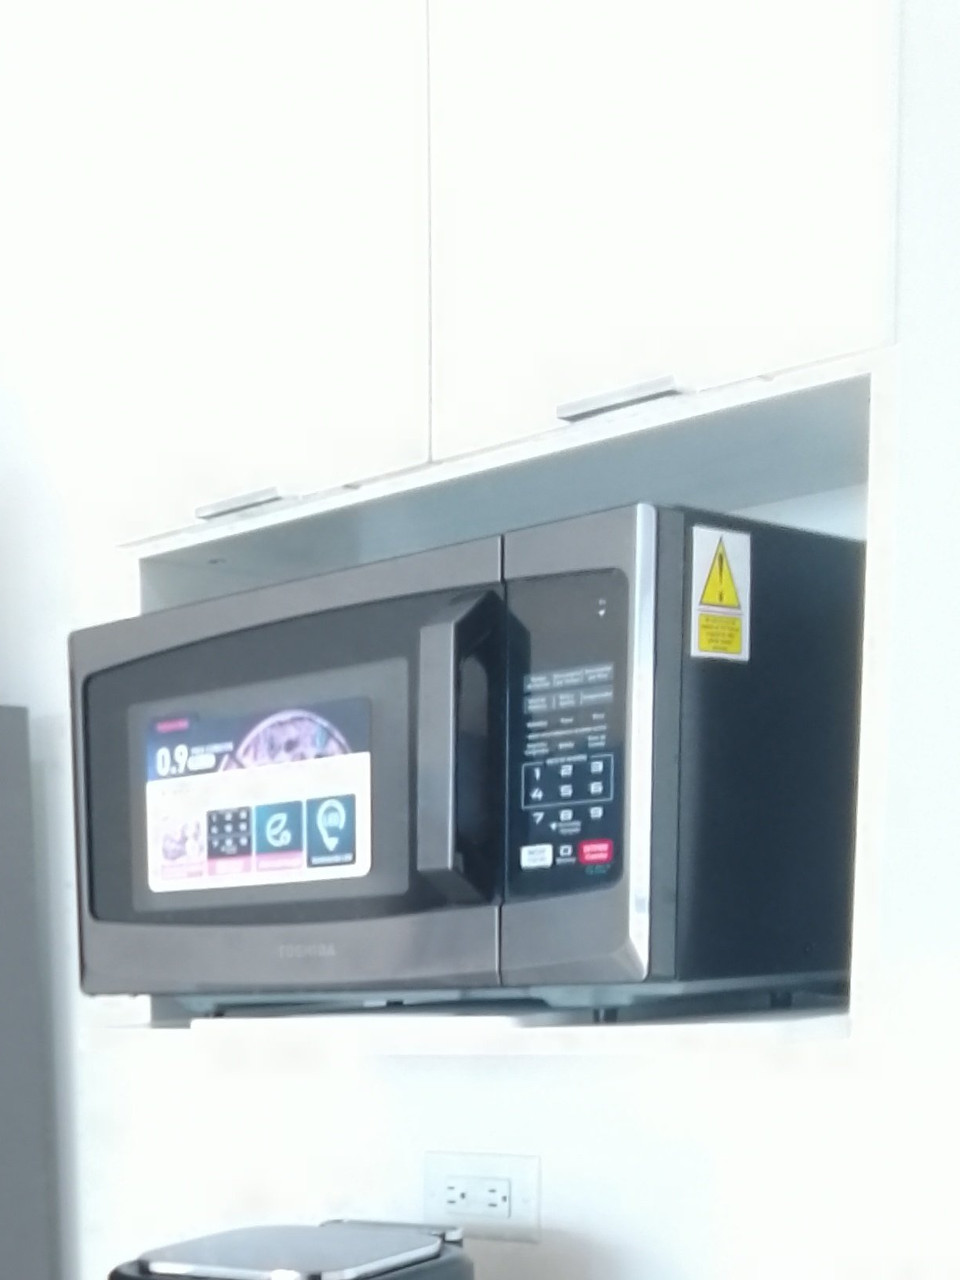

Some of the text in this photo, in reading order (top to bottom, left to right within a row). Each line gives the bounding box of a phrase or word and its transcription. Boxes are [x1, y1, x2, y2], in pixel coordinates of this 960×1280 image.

[157, 744, 188, 776] 0.9
[534, 761, 603, 780] 1 2 3
[530, 781, 603, 800] 4 5 6
[532, 806, 603, 824] 7 8 9
